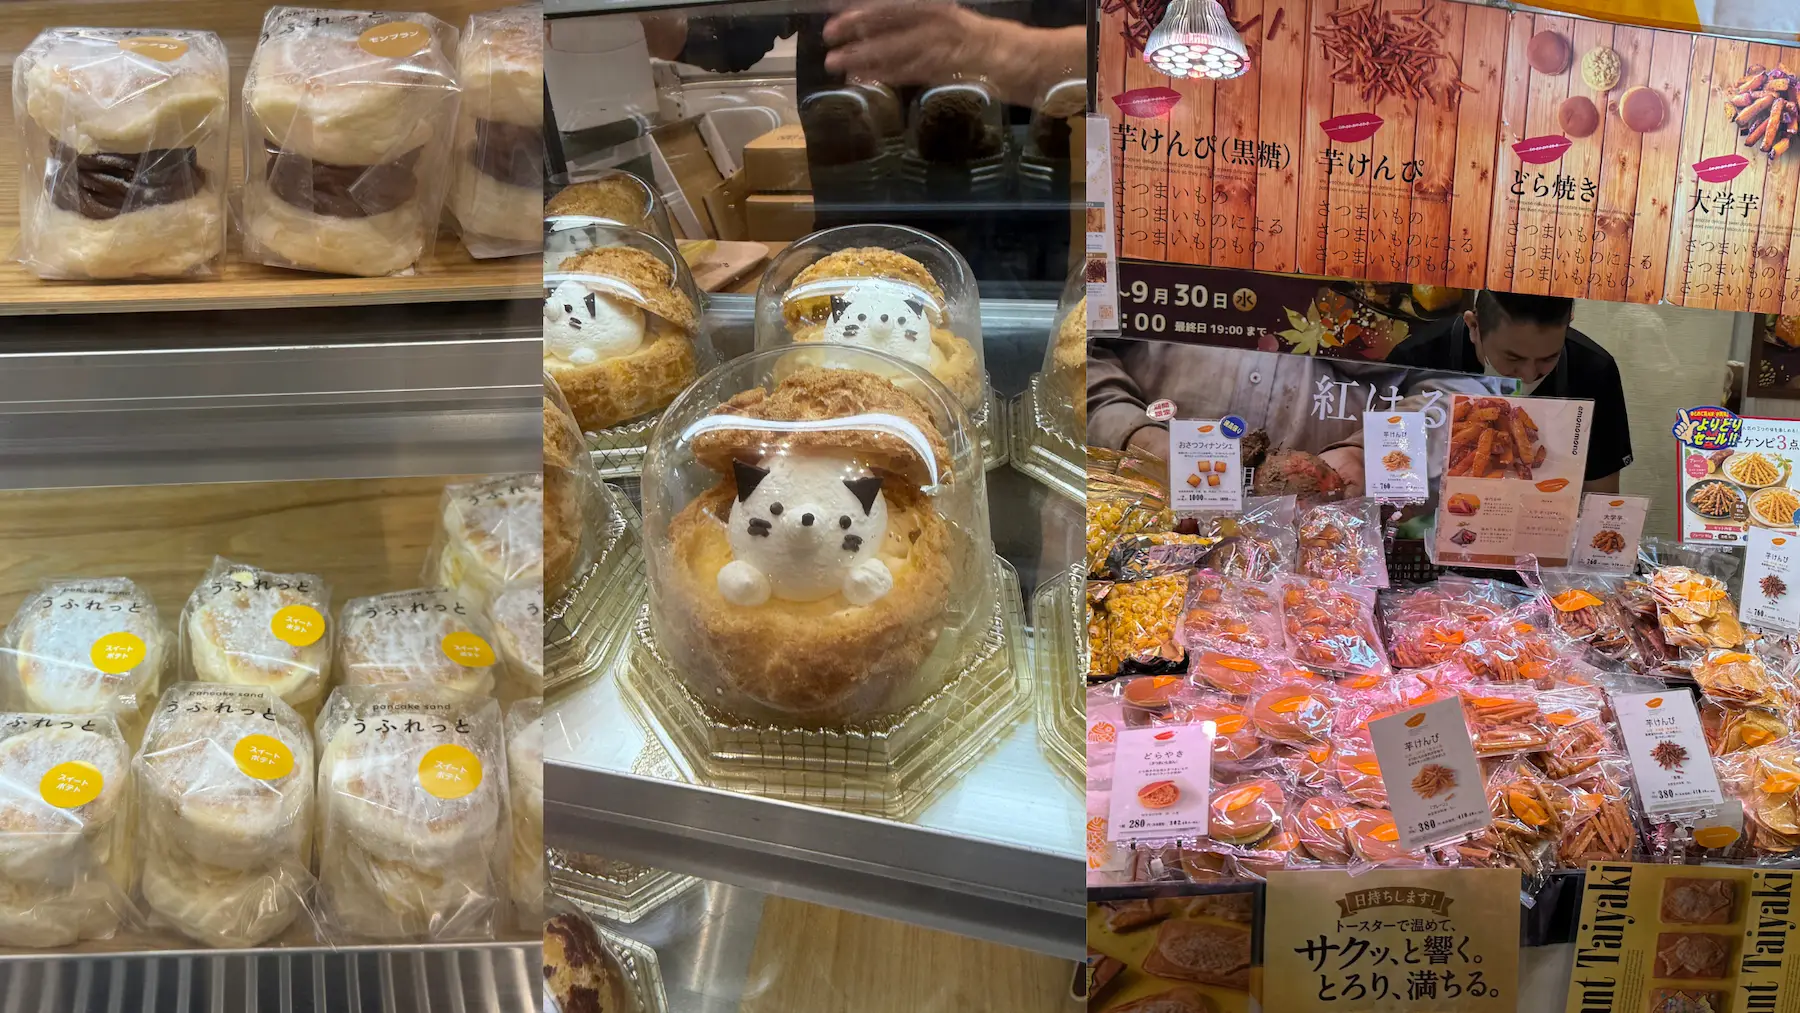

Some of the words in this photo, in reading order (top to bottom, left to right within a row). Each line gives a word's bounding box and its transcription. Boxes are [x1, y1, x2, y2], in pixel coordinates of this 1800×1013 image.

[368, 30, 420, 43] モンブラン
[1318, 148, 1424, 183] 芋けんぴ
[1510, 170, 1598, 203] どら焼き
[1687, 188, 1760, 219] 大学芋
[1696, 417, 1743, 432] よりどり
[1178, 441, 1234, 450] おさつフィナンシェ
[188, 690, 234, 698] pancake
[372, 703, 420, 713] pancake
[1144, 750, 1183, 760] どらやき
[1657, 788, 1674, 800] 380
[1129, 818, 1146, 829] 280
[1418, 819, 1436, 833] 380
[1355, 889, 1437, 908] 日持ちします!
[1576, 865, 1636, 968] Taiyaki
[1741, 871, 1797, 974] Taiyaki
[1336, 918, 1457, 933] トースターで温めて、
[1294, 934, 1483, 972] サクッ、と響く。
[1318, 969, 1500, 1001] とろり、満ちる。
